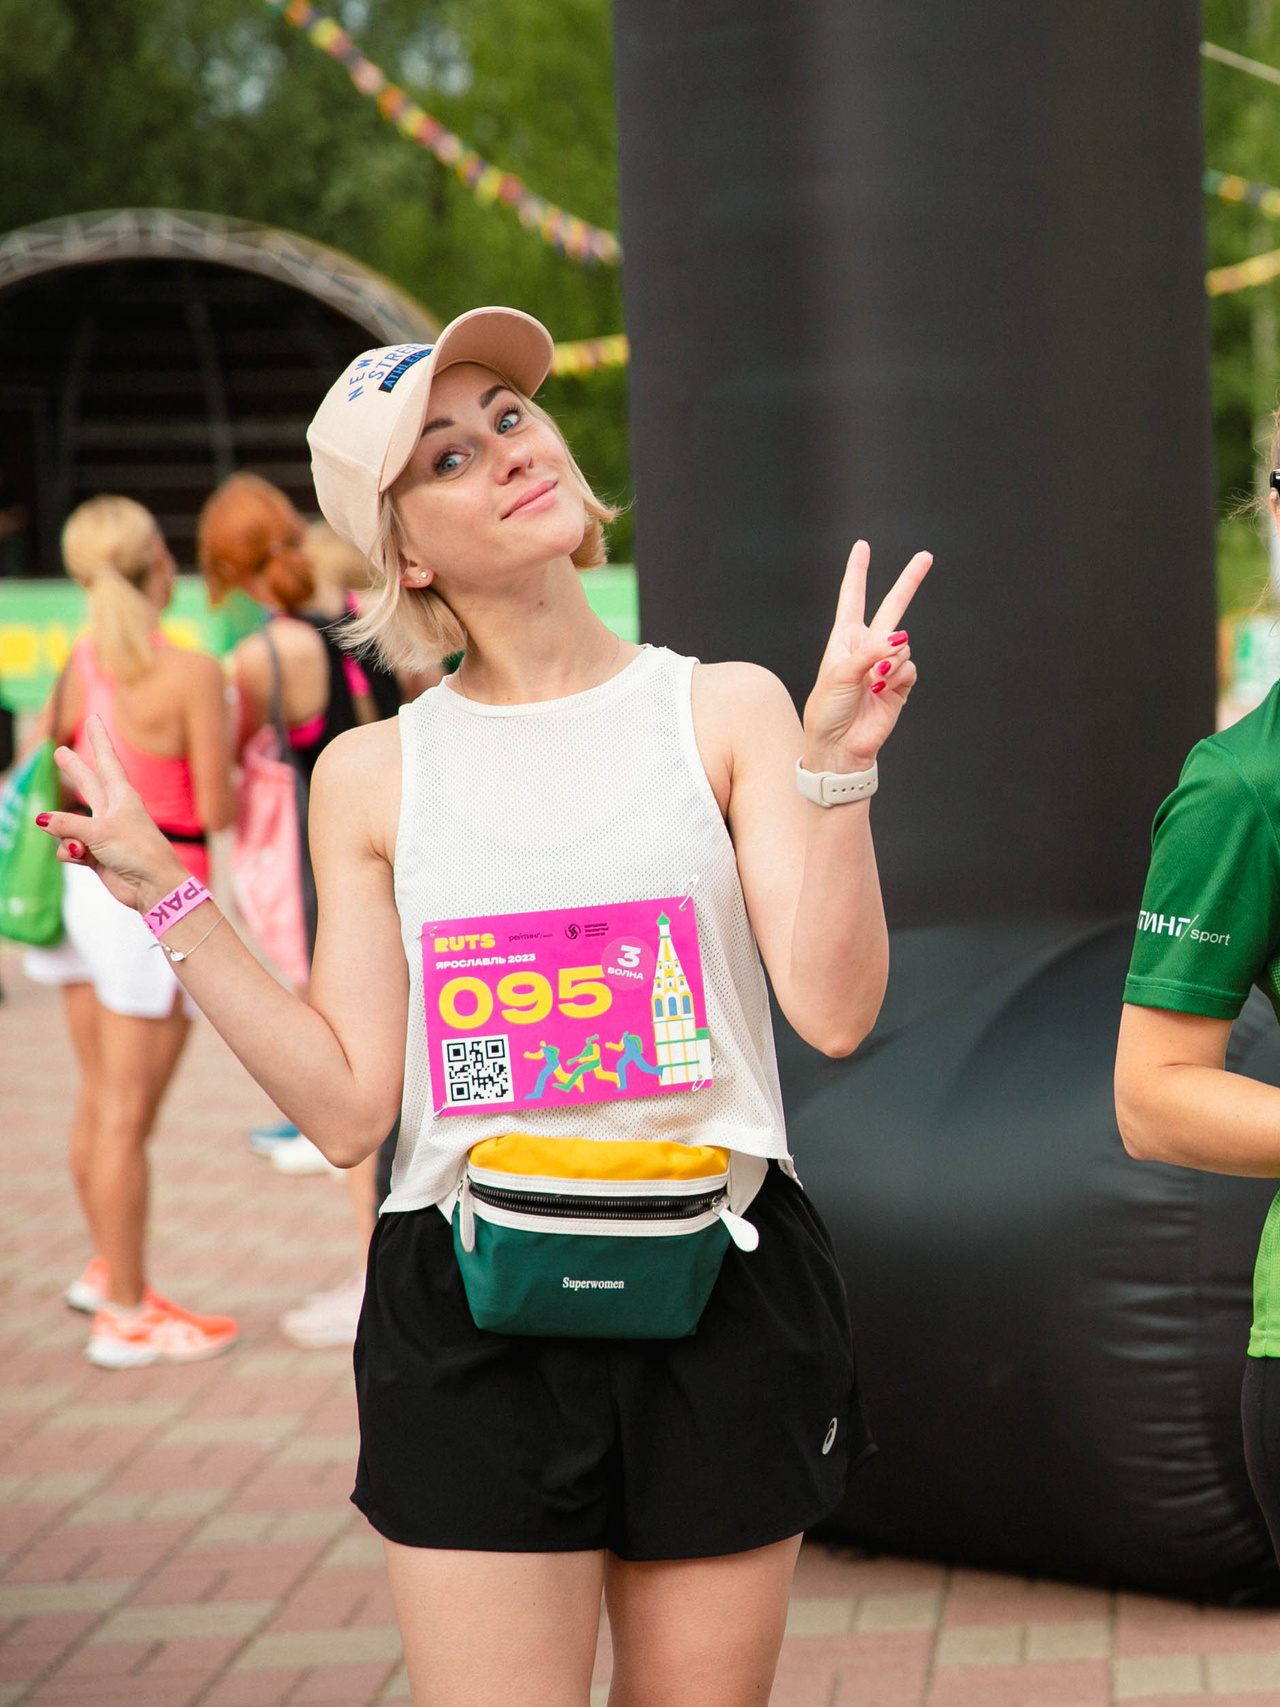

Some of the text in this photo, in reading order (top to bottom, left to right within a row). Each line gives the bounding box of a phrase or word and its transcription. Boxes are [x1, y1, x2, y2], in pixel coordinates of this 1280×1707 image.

[368, 344, 423, 381] STREE
[348, 358, 373, 402] NEW
[434, 933, 496, 953] RUTS
[435, 953, 537, 970] ЯРОСЛАВЛЬ 2023
[617, 944, 642, 968] 3
[607, 966, 644, 980] ВОЛНА
[438, 964, 613, 1030] 095
[562, 1276, 625, 1291] Superwomen
